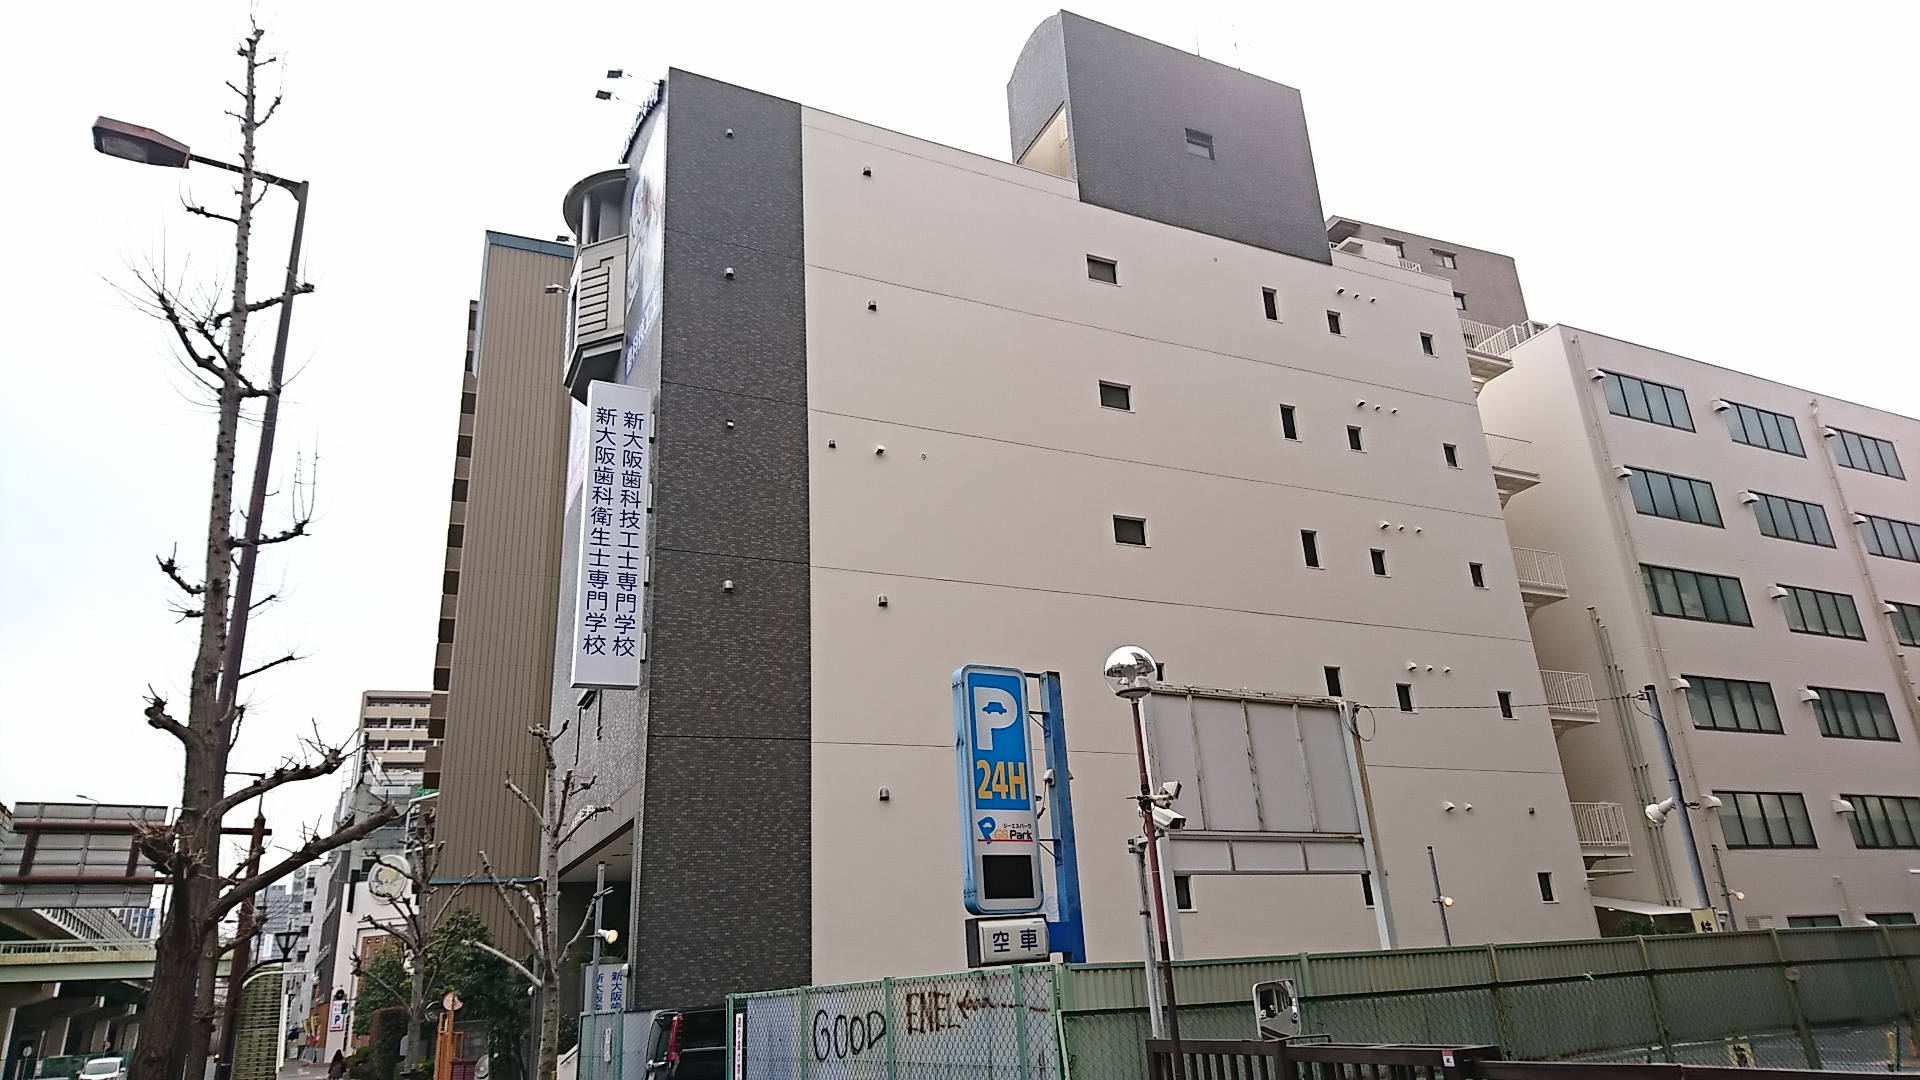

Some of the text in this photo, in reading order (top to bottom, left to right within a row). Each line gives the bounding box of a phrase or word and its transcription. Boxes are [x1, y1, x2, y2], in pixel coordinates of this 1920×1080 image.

[583, 407, 617, 656] 新大阪歯科衛生士専門学校
[612, 411, 644, 657] 新大阪歯科技工士専門学校
[974, 687, 1017, 750] P
[977, 761, 1026, 800] 24H
[1010, 830, 1032, 840] Park
[993, 928, 1038, 952] 空車
[814, 1010, 887, 1060] GOOD
